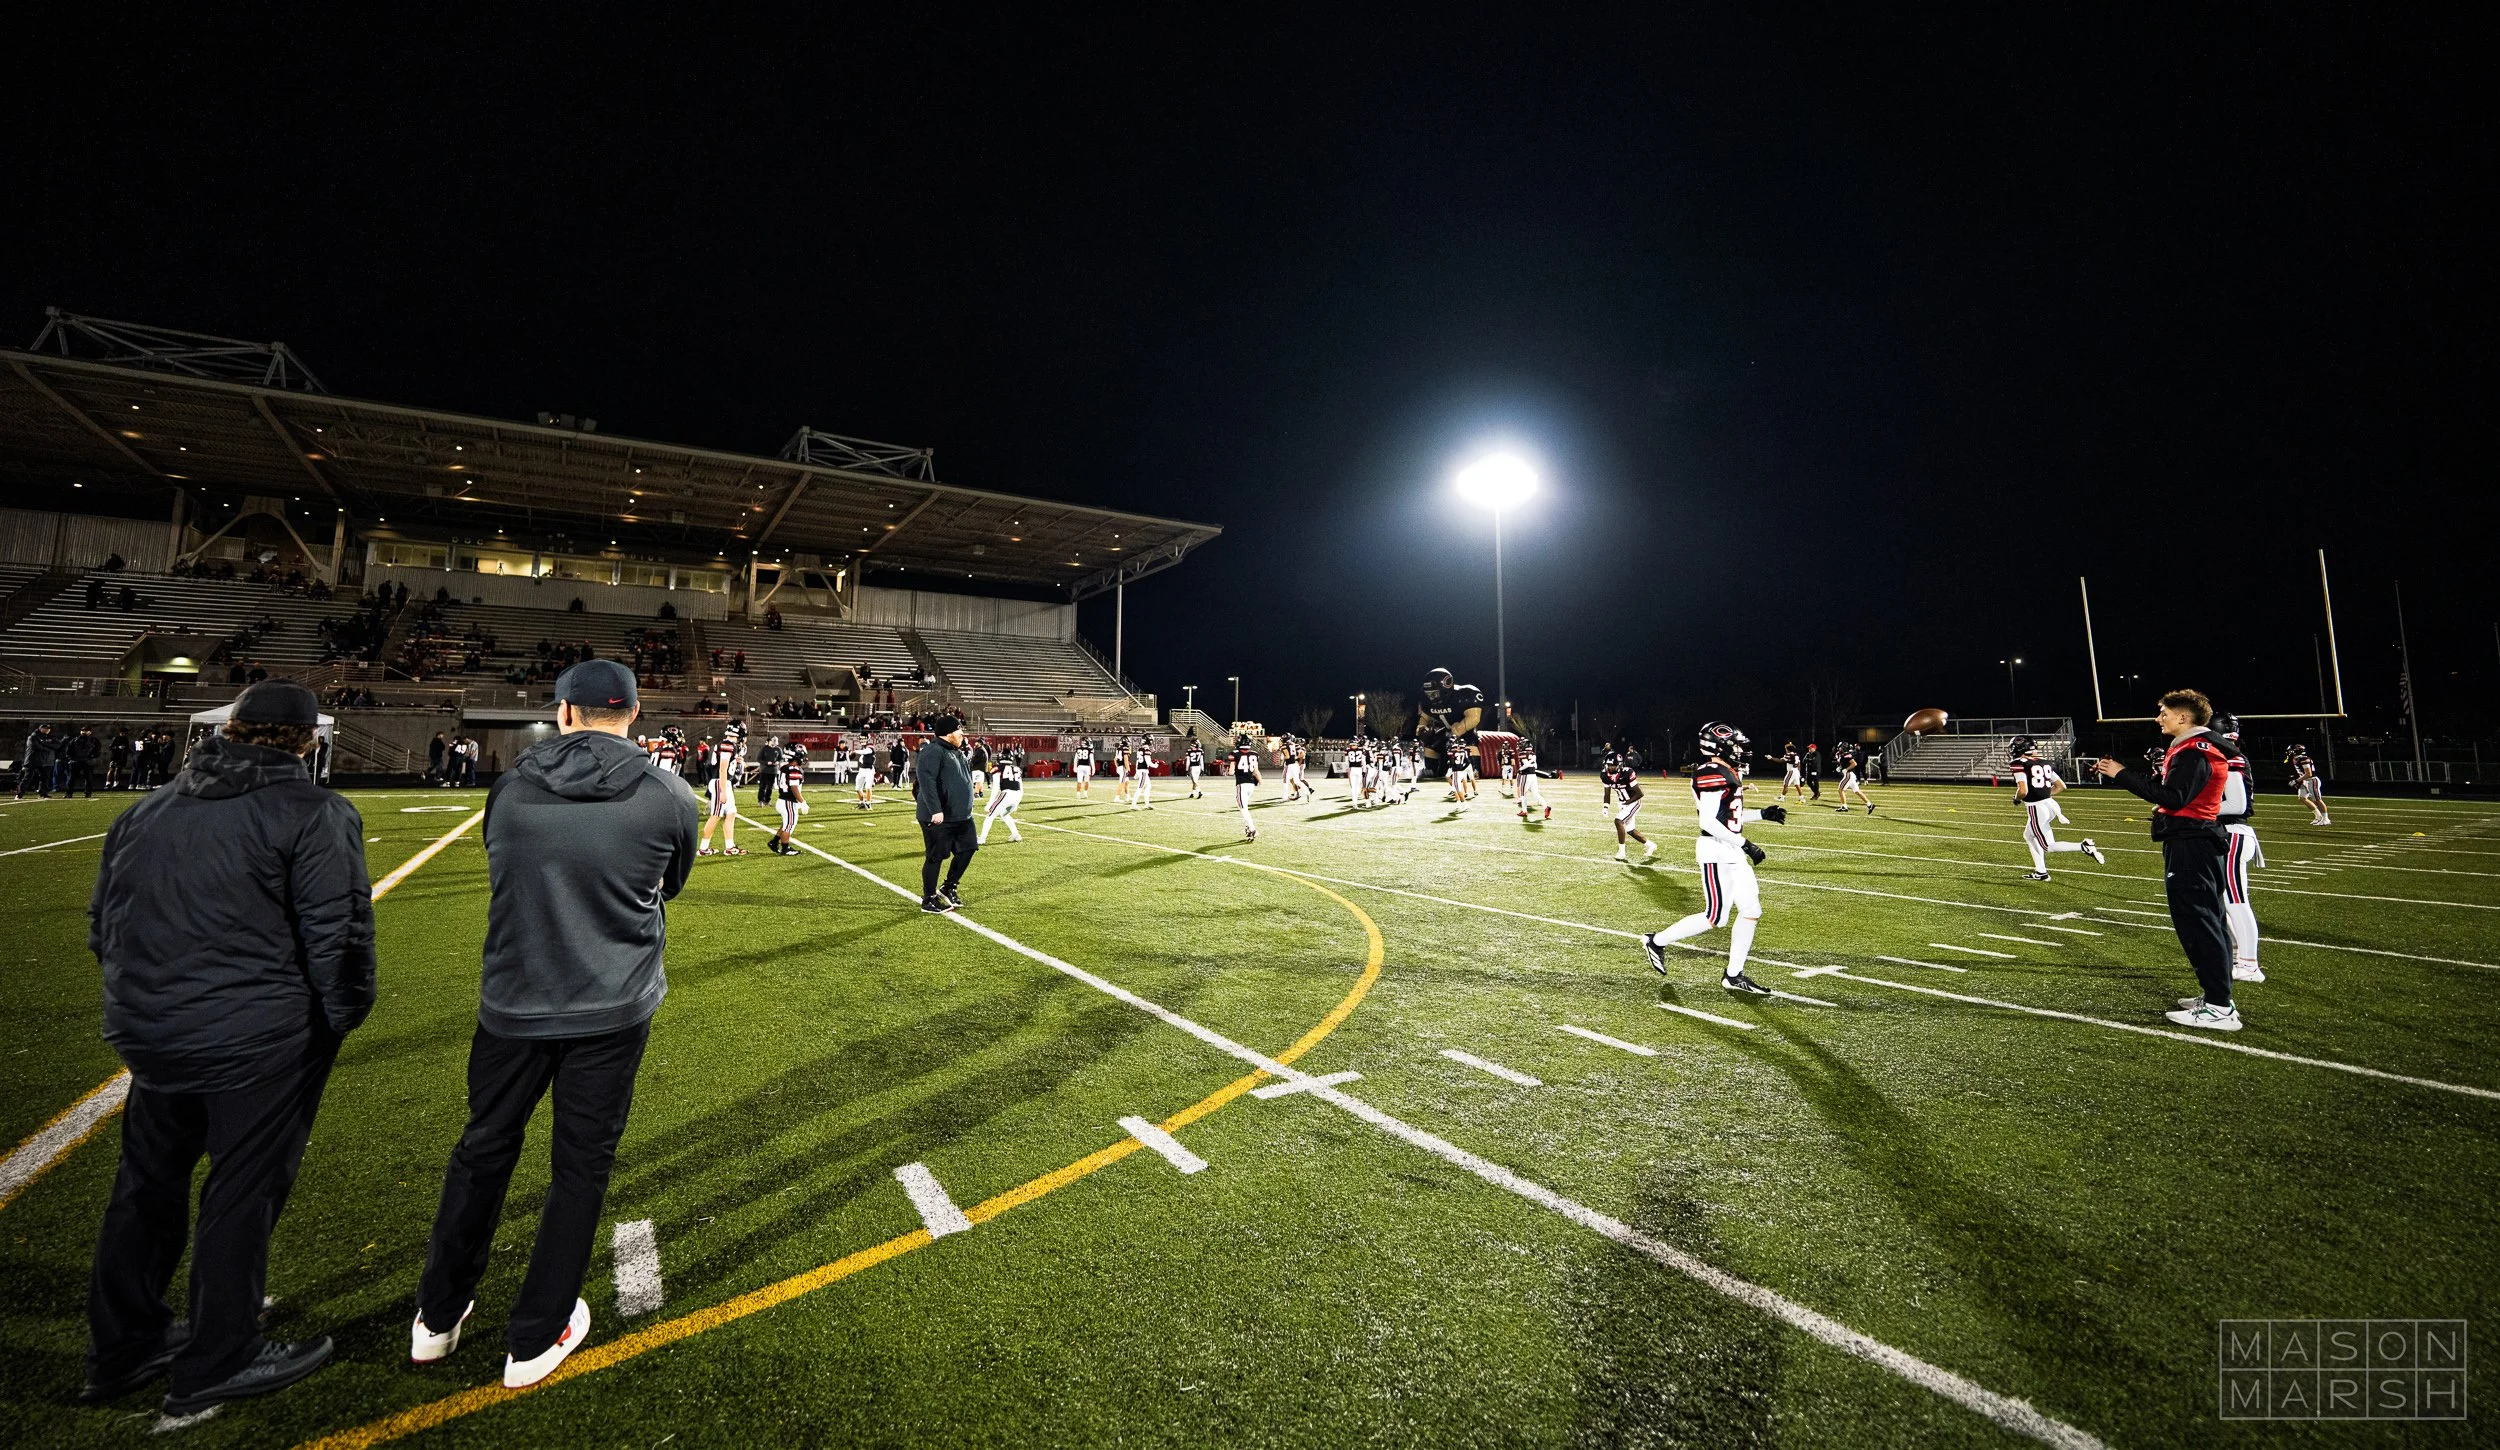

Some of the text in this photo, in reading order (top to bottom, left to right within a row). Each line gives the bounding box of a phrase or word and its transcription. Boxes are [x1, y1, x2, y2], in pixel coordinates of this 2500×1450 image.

[455, 744, 467, 754] 49
[1077, 749, 1089, 760] 38
[1190, 752, 1201, 762] 27
[1348, 751, 1362, 763] 82
[1454, 752, 1465, 764] 37
[1237, 755, 1258, 773] 48
[1003, 765, 1022, 782] 42
[2031, 764, 2052, 788] 89
